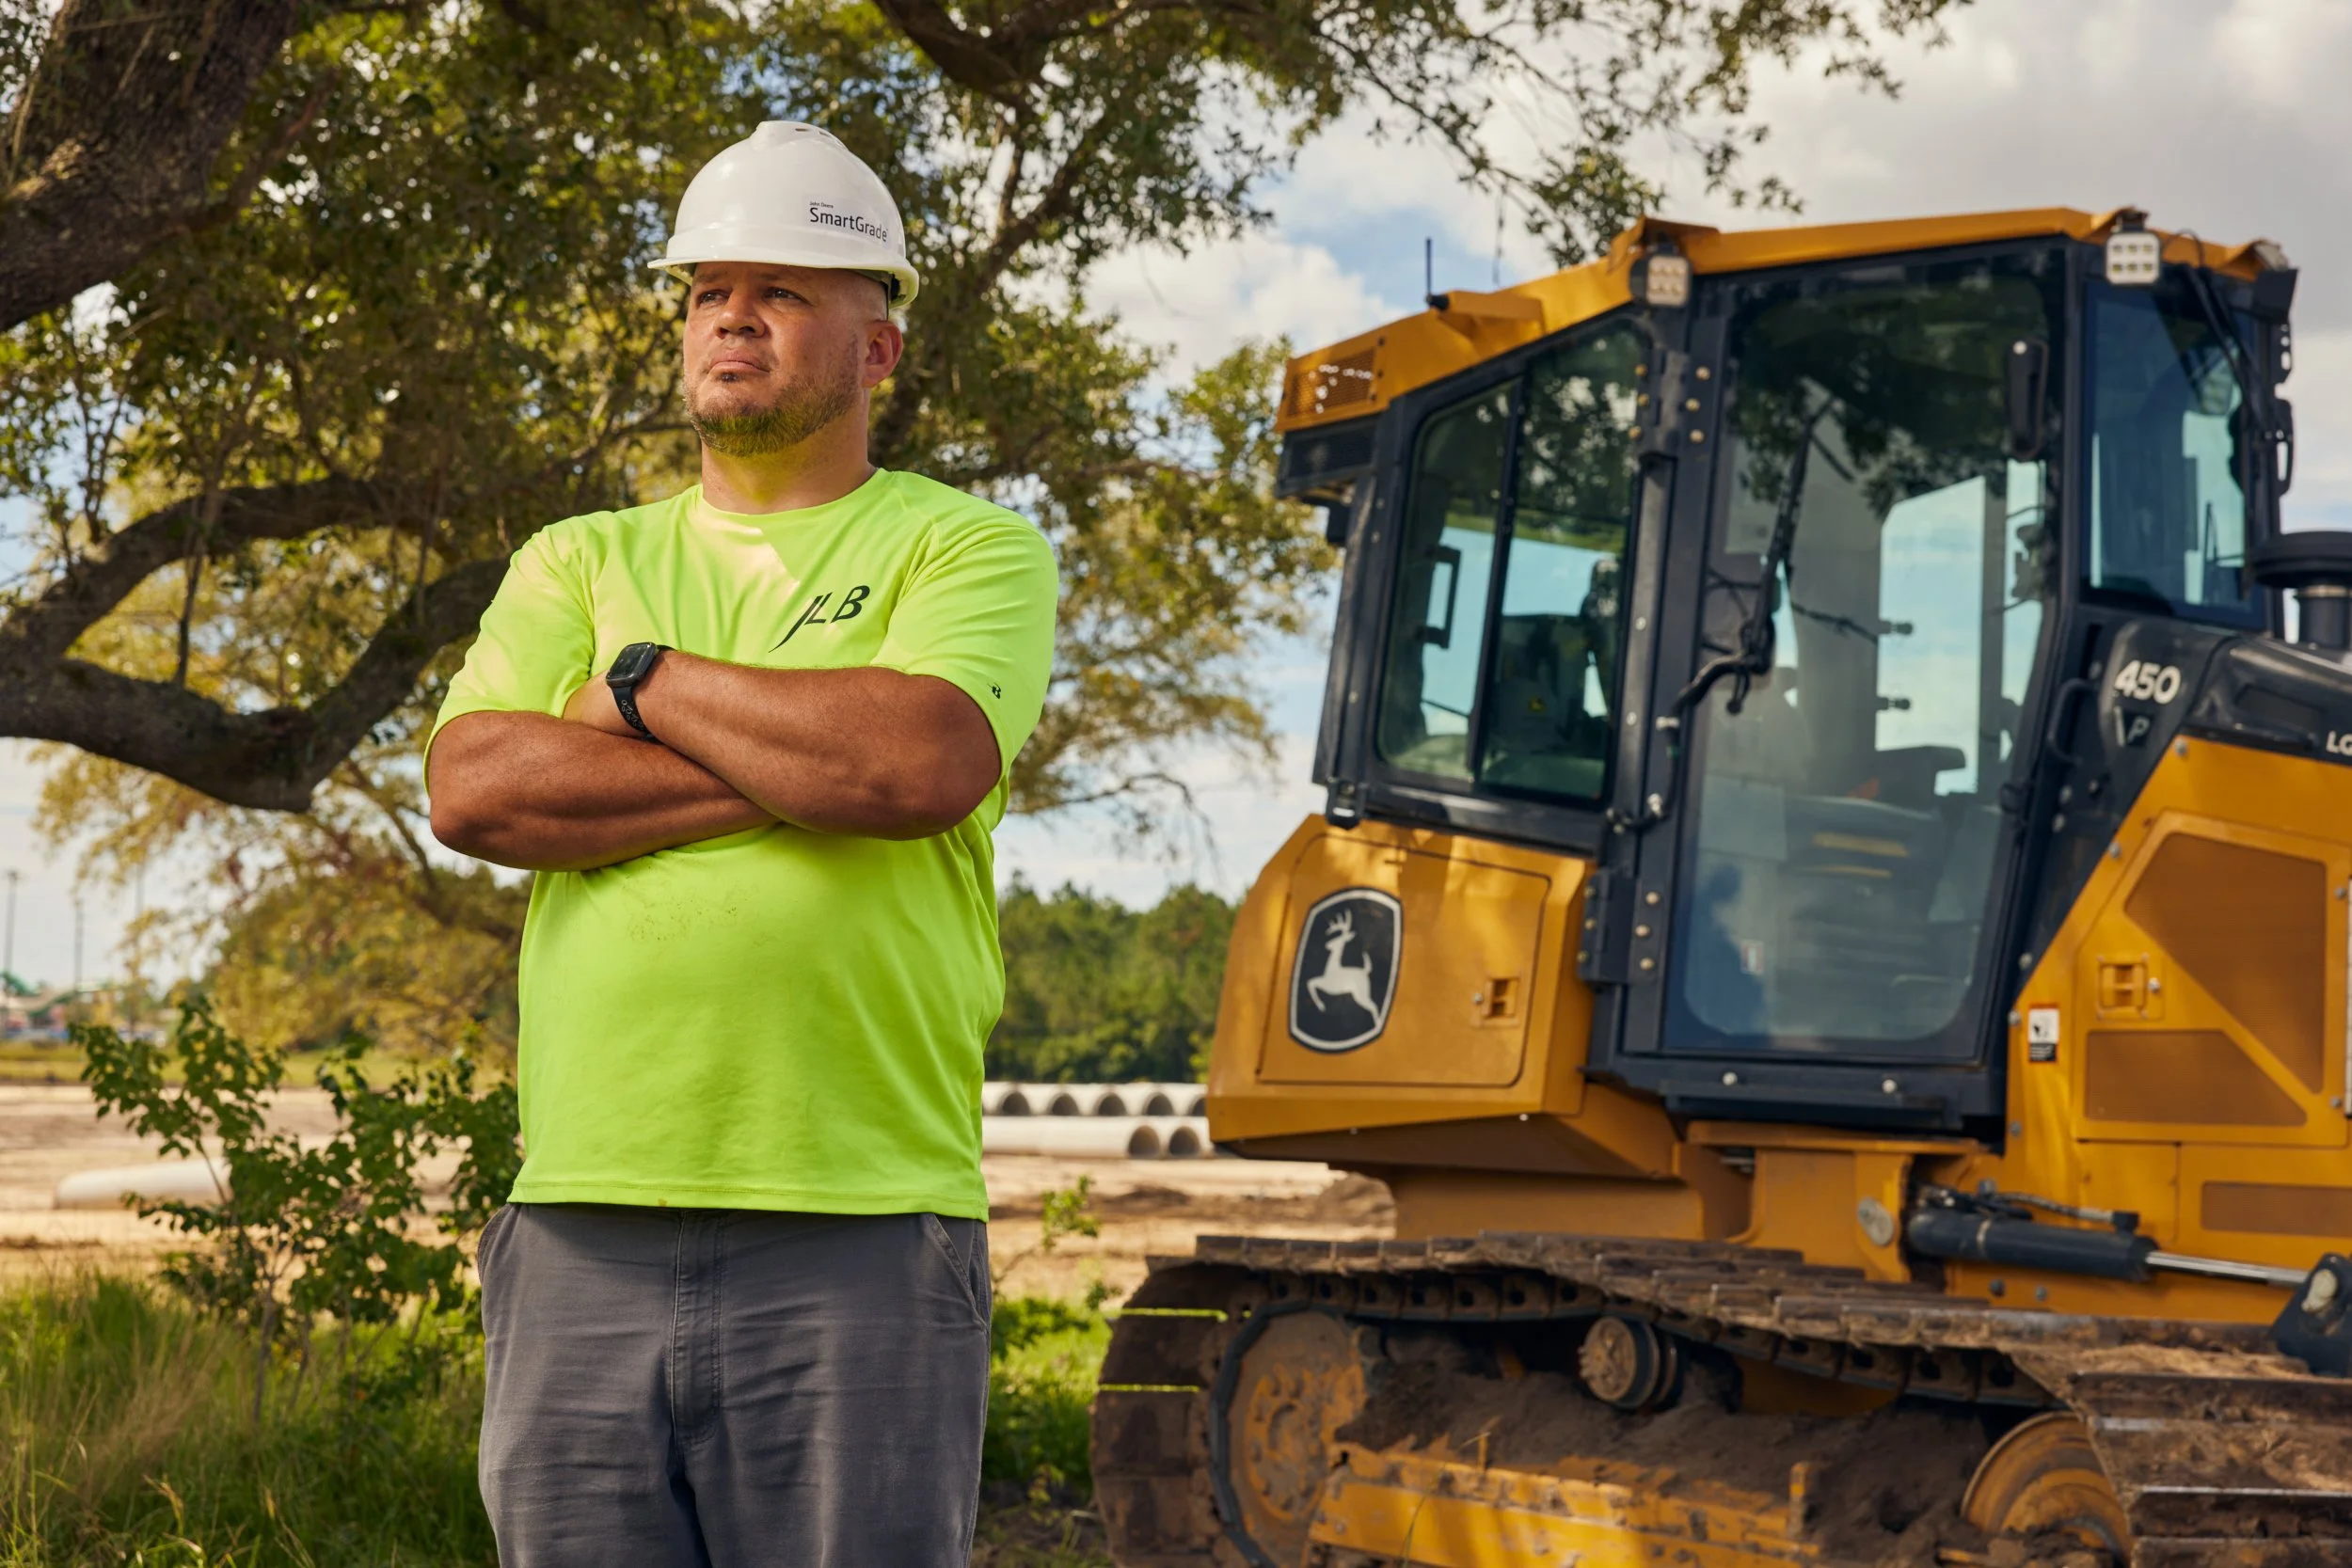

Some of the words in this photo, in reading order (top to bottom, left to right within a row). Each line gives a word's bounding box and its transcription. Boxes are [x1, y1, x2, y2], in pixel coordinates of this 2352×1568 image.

[809, 207, 887, 243] SmartGrade
[2114, 659, 2182, 704] 450
[2127, 715, 2151, 743] P
